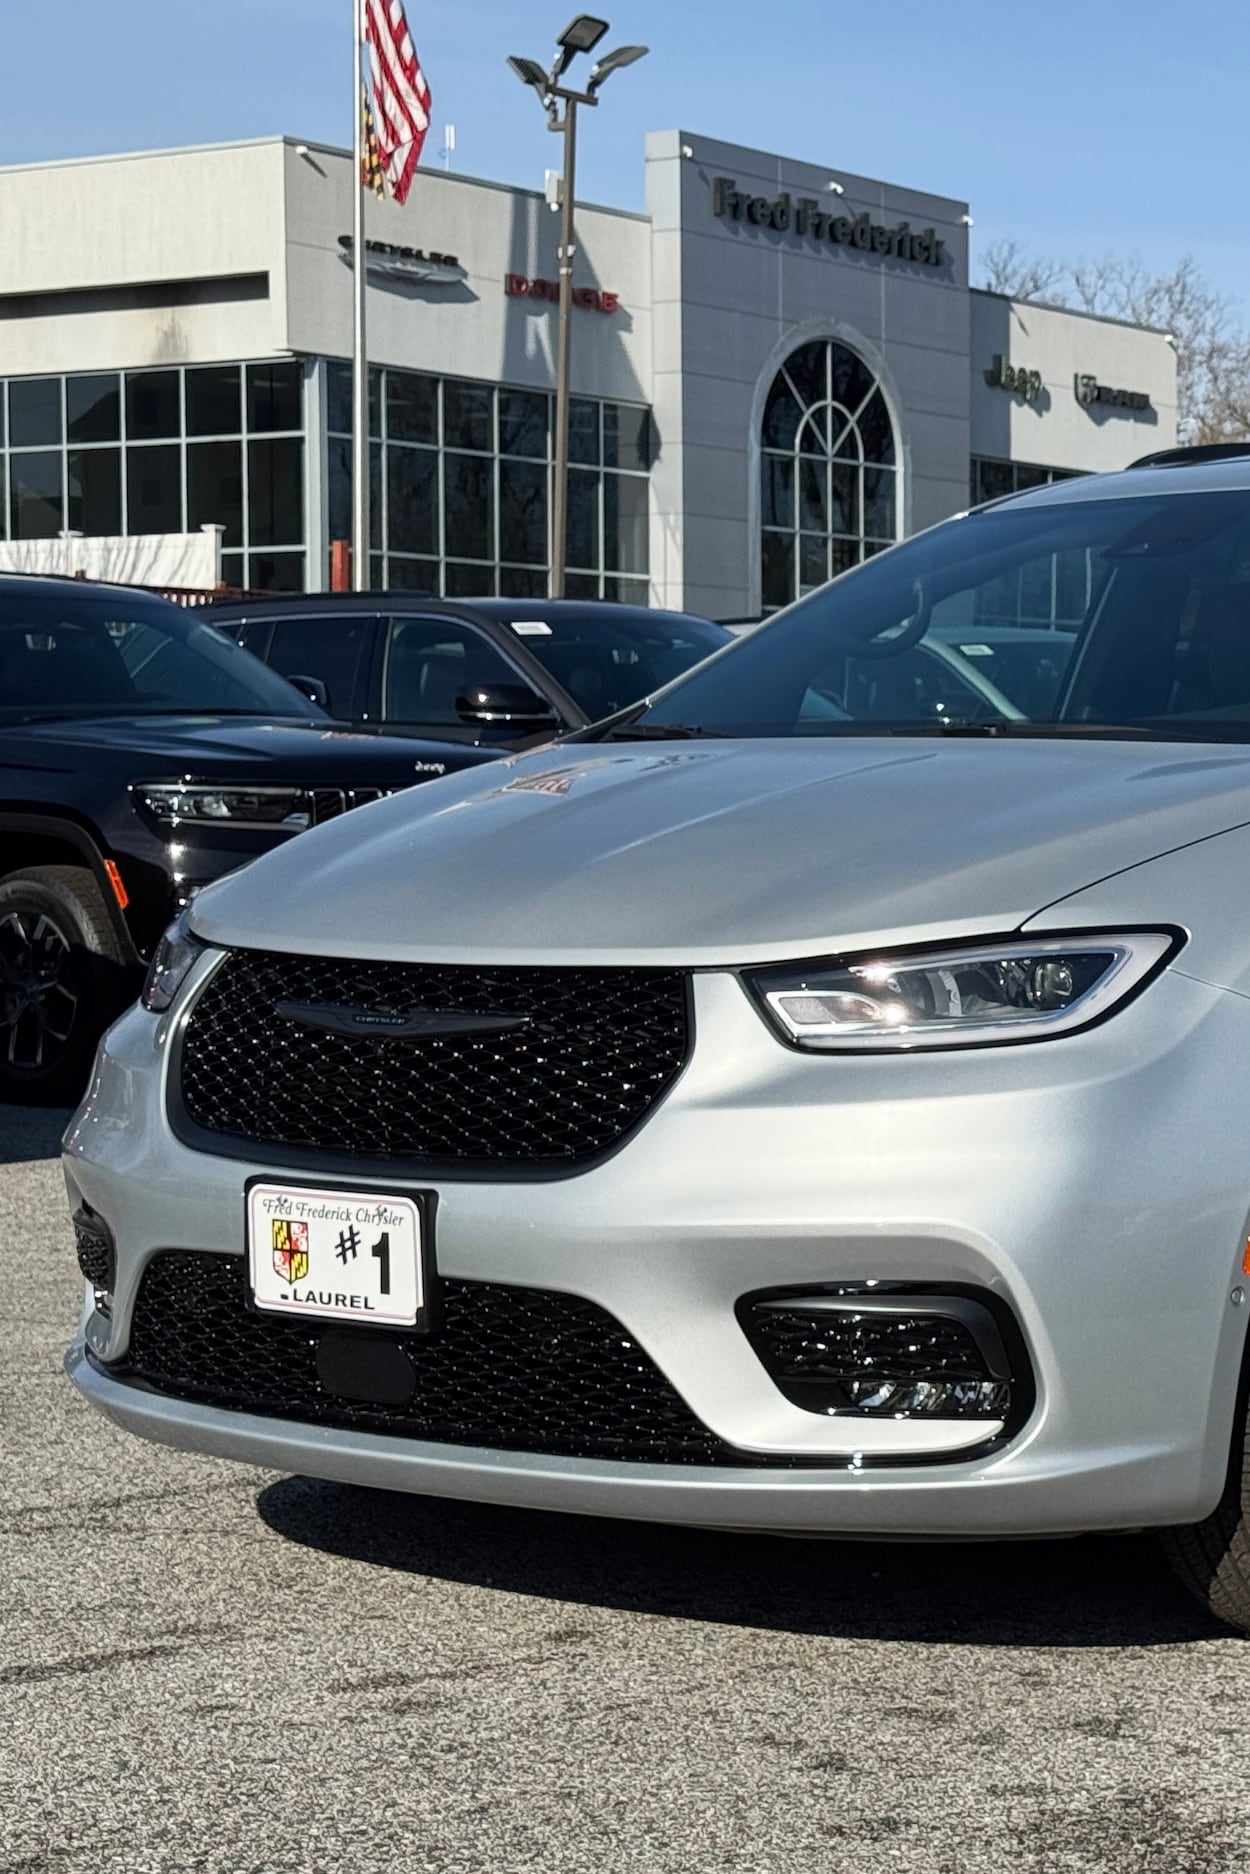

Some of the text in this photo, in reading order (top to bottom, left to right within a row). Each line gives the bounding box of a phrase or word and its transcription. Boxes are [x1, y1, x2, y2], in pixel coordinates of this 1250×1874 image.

[713, 177, 945, 266] Fred Frederick
[262, 1198, 405, 1227] Fred Frederick Chrysler
[293, 1288, 376, 1310] LAUREL
